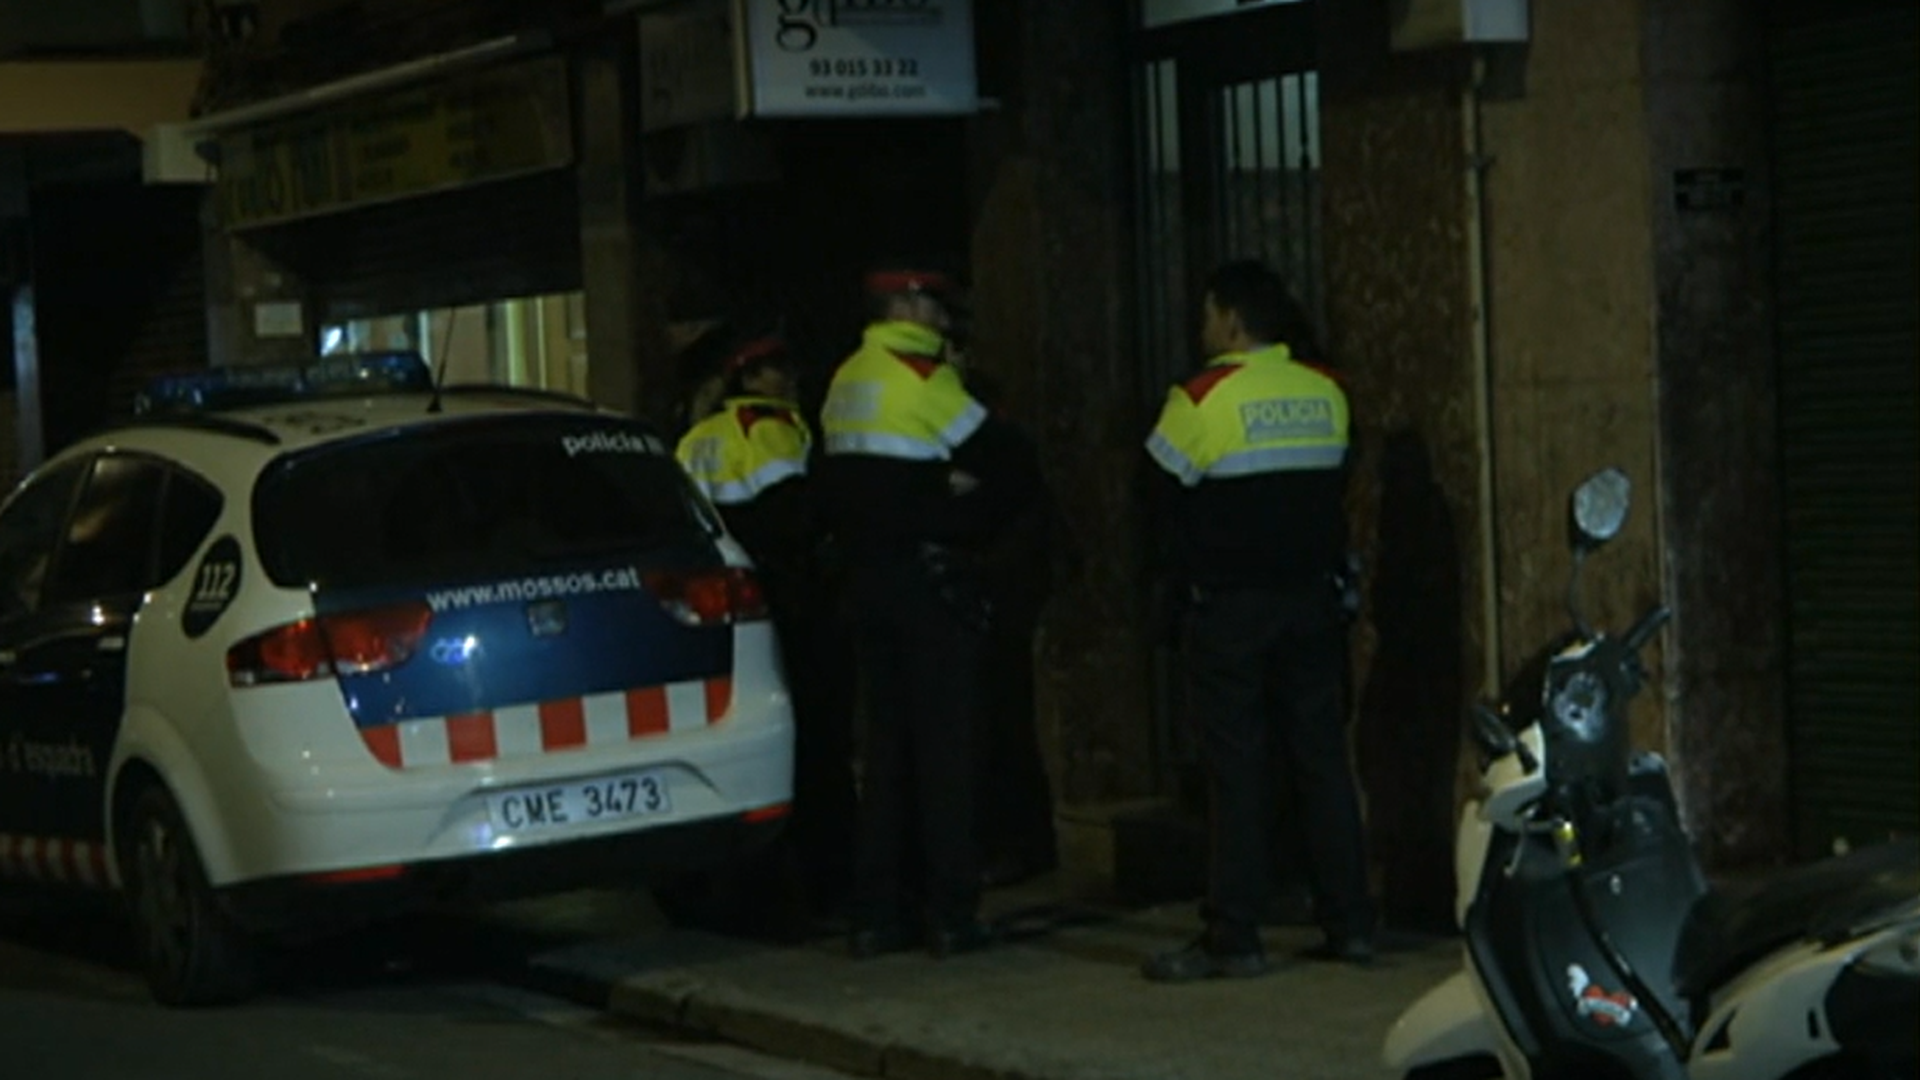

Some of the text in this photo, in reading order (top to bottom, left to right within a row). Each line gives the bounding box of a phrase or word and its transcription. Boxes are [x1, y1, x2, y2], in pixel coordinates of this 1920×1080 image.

[808, 58, 919, 77] 93 015 33 22
[1243, 399, 1331, 427] POLICIA
[561, 430, 646, 458] policia
[195, 561, 236, 601] 112
[426, 565, 642, 613] www.mossos.cat
[502, 777, 661, 829] CME 3473
